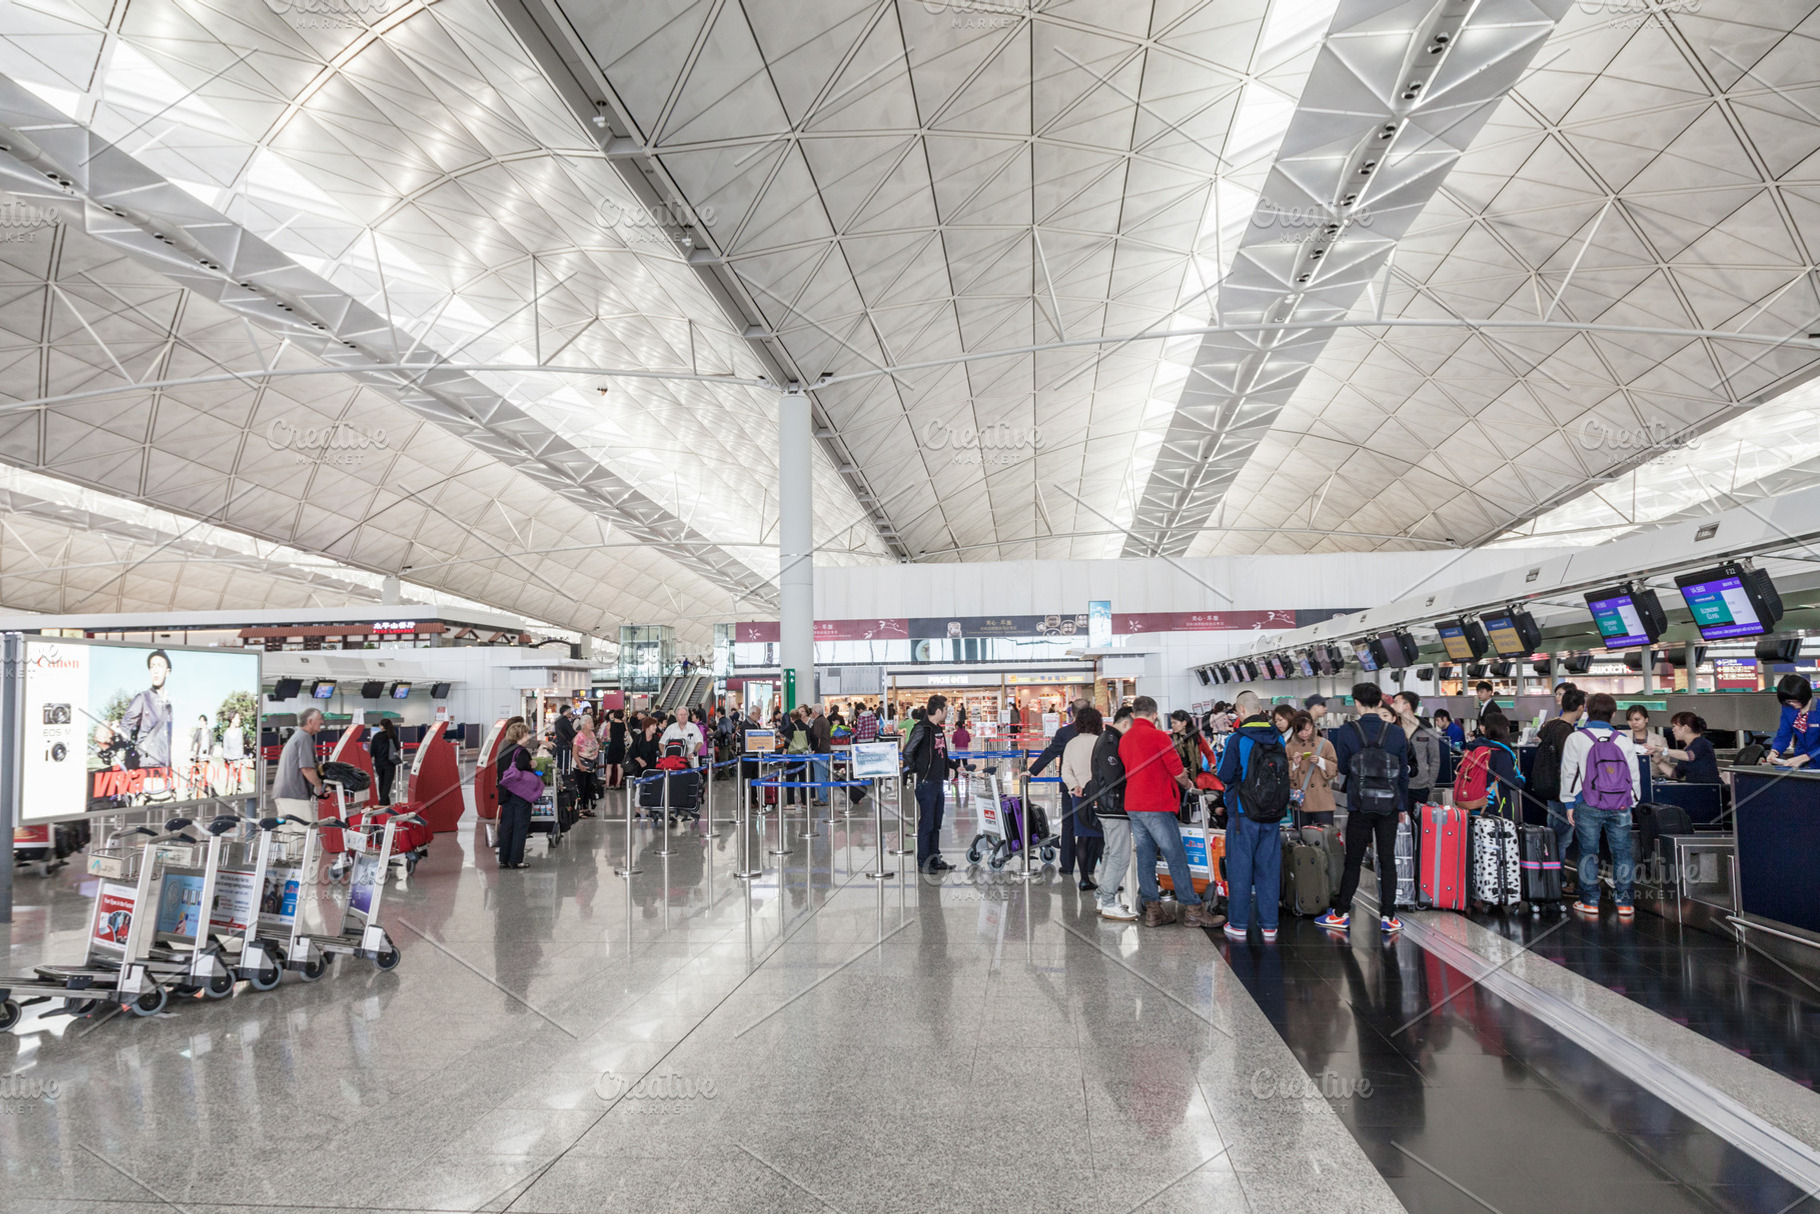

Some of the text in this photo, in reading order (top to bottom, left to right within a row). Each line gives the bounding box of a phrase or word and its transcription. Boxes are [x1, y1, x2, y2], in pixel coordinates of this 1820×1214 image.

[37, 656, 80, 668] Canon
[1588, 664, 1629, 674] swatch
[43, 728, 62, 737] EOS
[93, 764, 148, 799] viva
